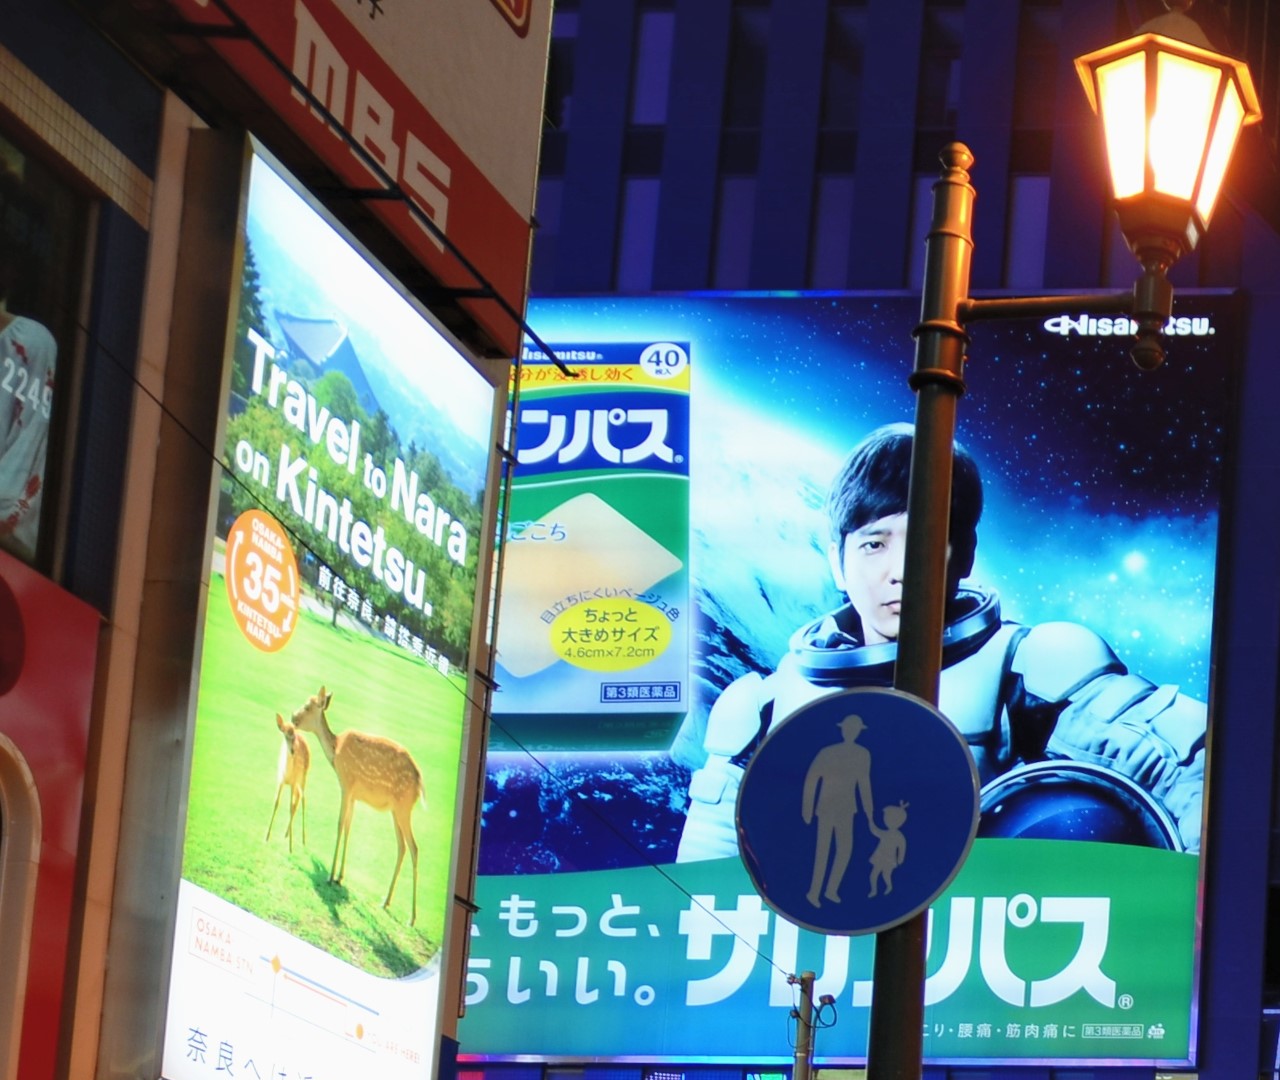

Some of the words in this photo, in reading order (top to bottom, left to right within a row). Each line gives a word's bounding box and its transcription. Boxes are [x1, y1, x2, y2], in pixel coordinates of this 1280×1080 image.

[291, 0, 453, 255] MBS
[1045, 314, 1216, 336] Hisatsu.
[647, 350, 681, 369] 40
[246, 328, 361, 477] Travel
[364, 456, 387, 500] to
[391, 456, 468, 567] Nara
[518, 408, 684, 465] ンパス®
[235, 440, 270, 488] on
[275, 442, 433, 616] Kintetsu.
[242, 551, 282, 614] 35
[561, 627, 660, 644] 大きめサイズ
[585, 608, 637, 624] ちょっと
[606, 685, 676, 699] 第3類医薬品
